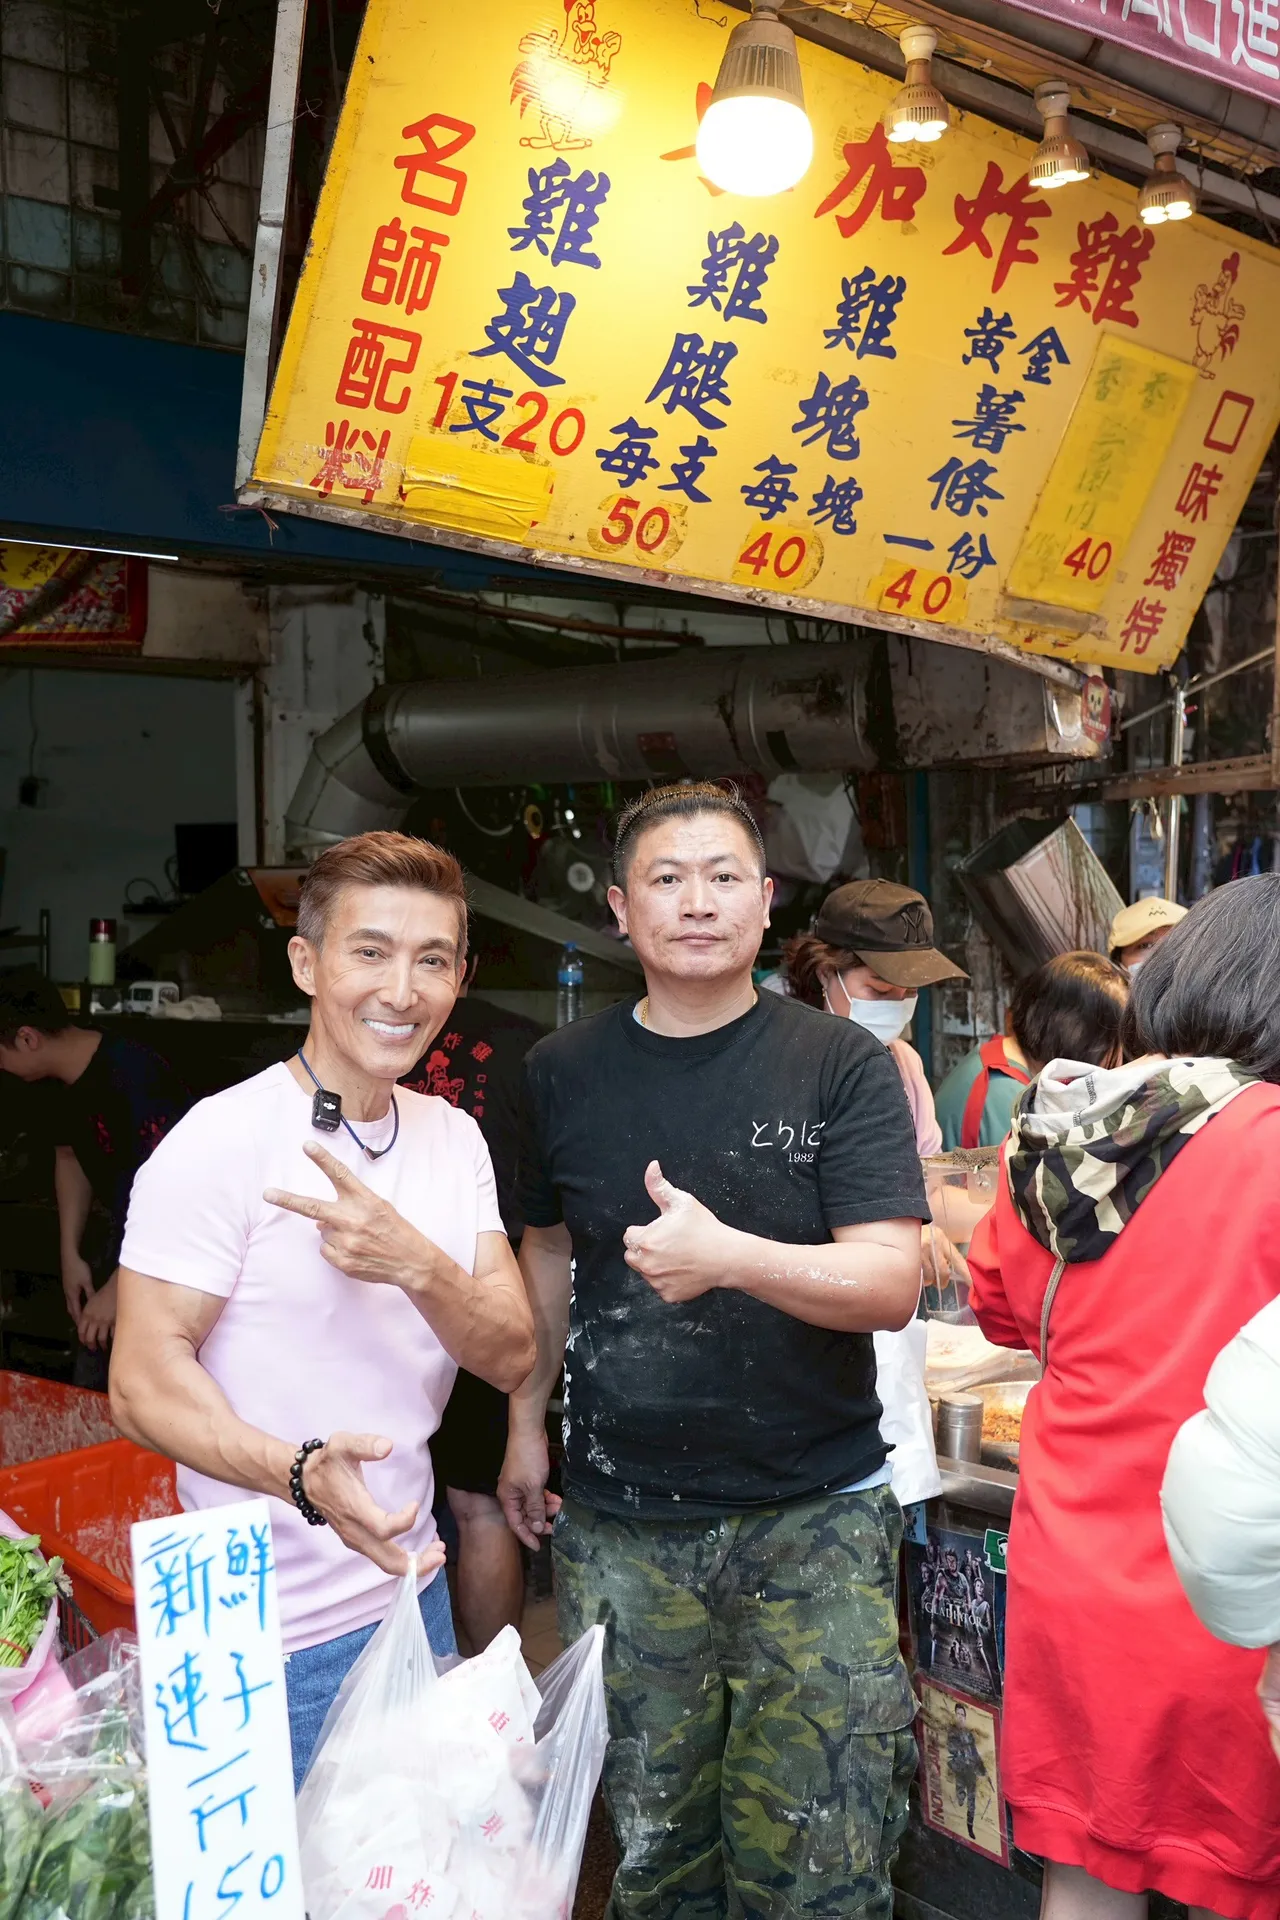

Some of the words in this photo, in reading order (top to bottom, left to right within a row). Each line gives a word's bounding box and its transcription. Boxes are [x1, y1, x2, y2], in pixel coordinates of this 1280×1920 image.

[659, 82, 1157, 329] 加炸雞
[310, 112, 476, 505] 名師配料
[468, 156, 611, 388] 雞翅
[645, 221, 779, 431] 雞腿
[791, 265, 906, 462] 雞塊
[595, 416, 713, 503] 每支
[740, 454, 863, 536] 每塊
[601, 497, 671, 553] 50
[738, 530, 806, 579] 40
[882, 531, 997, 580] 一份
[1063, 536, 1112, 581] 40
[1119, 390, 1254, 655] 口味獨特
[884, 568, 952, 616] 40
[788, 1152, 815, 1163] 1982
